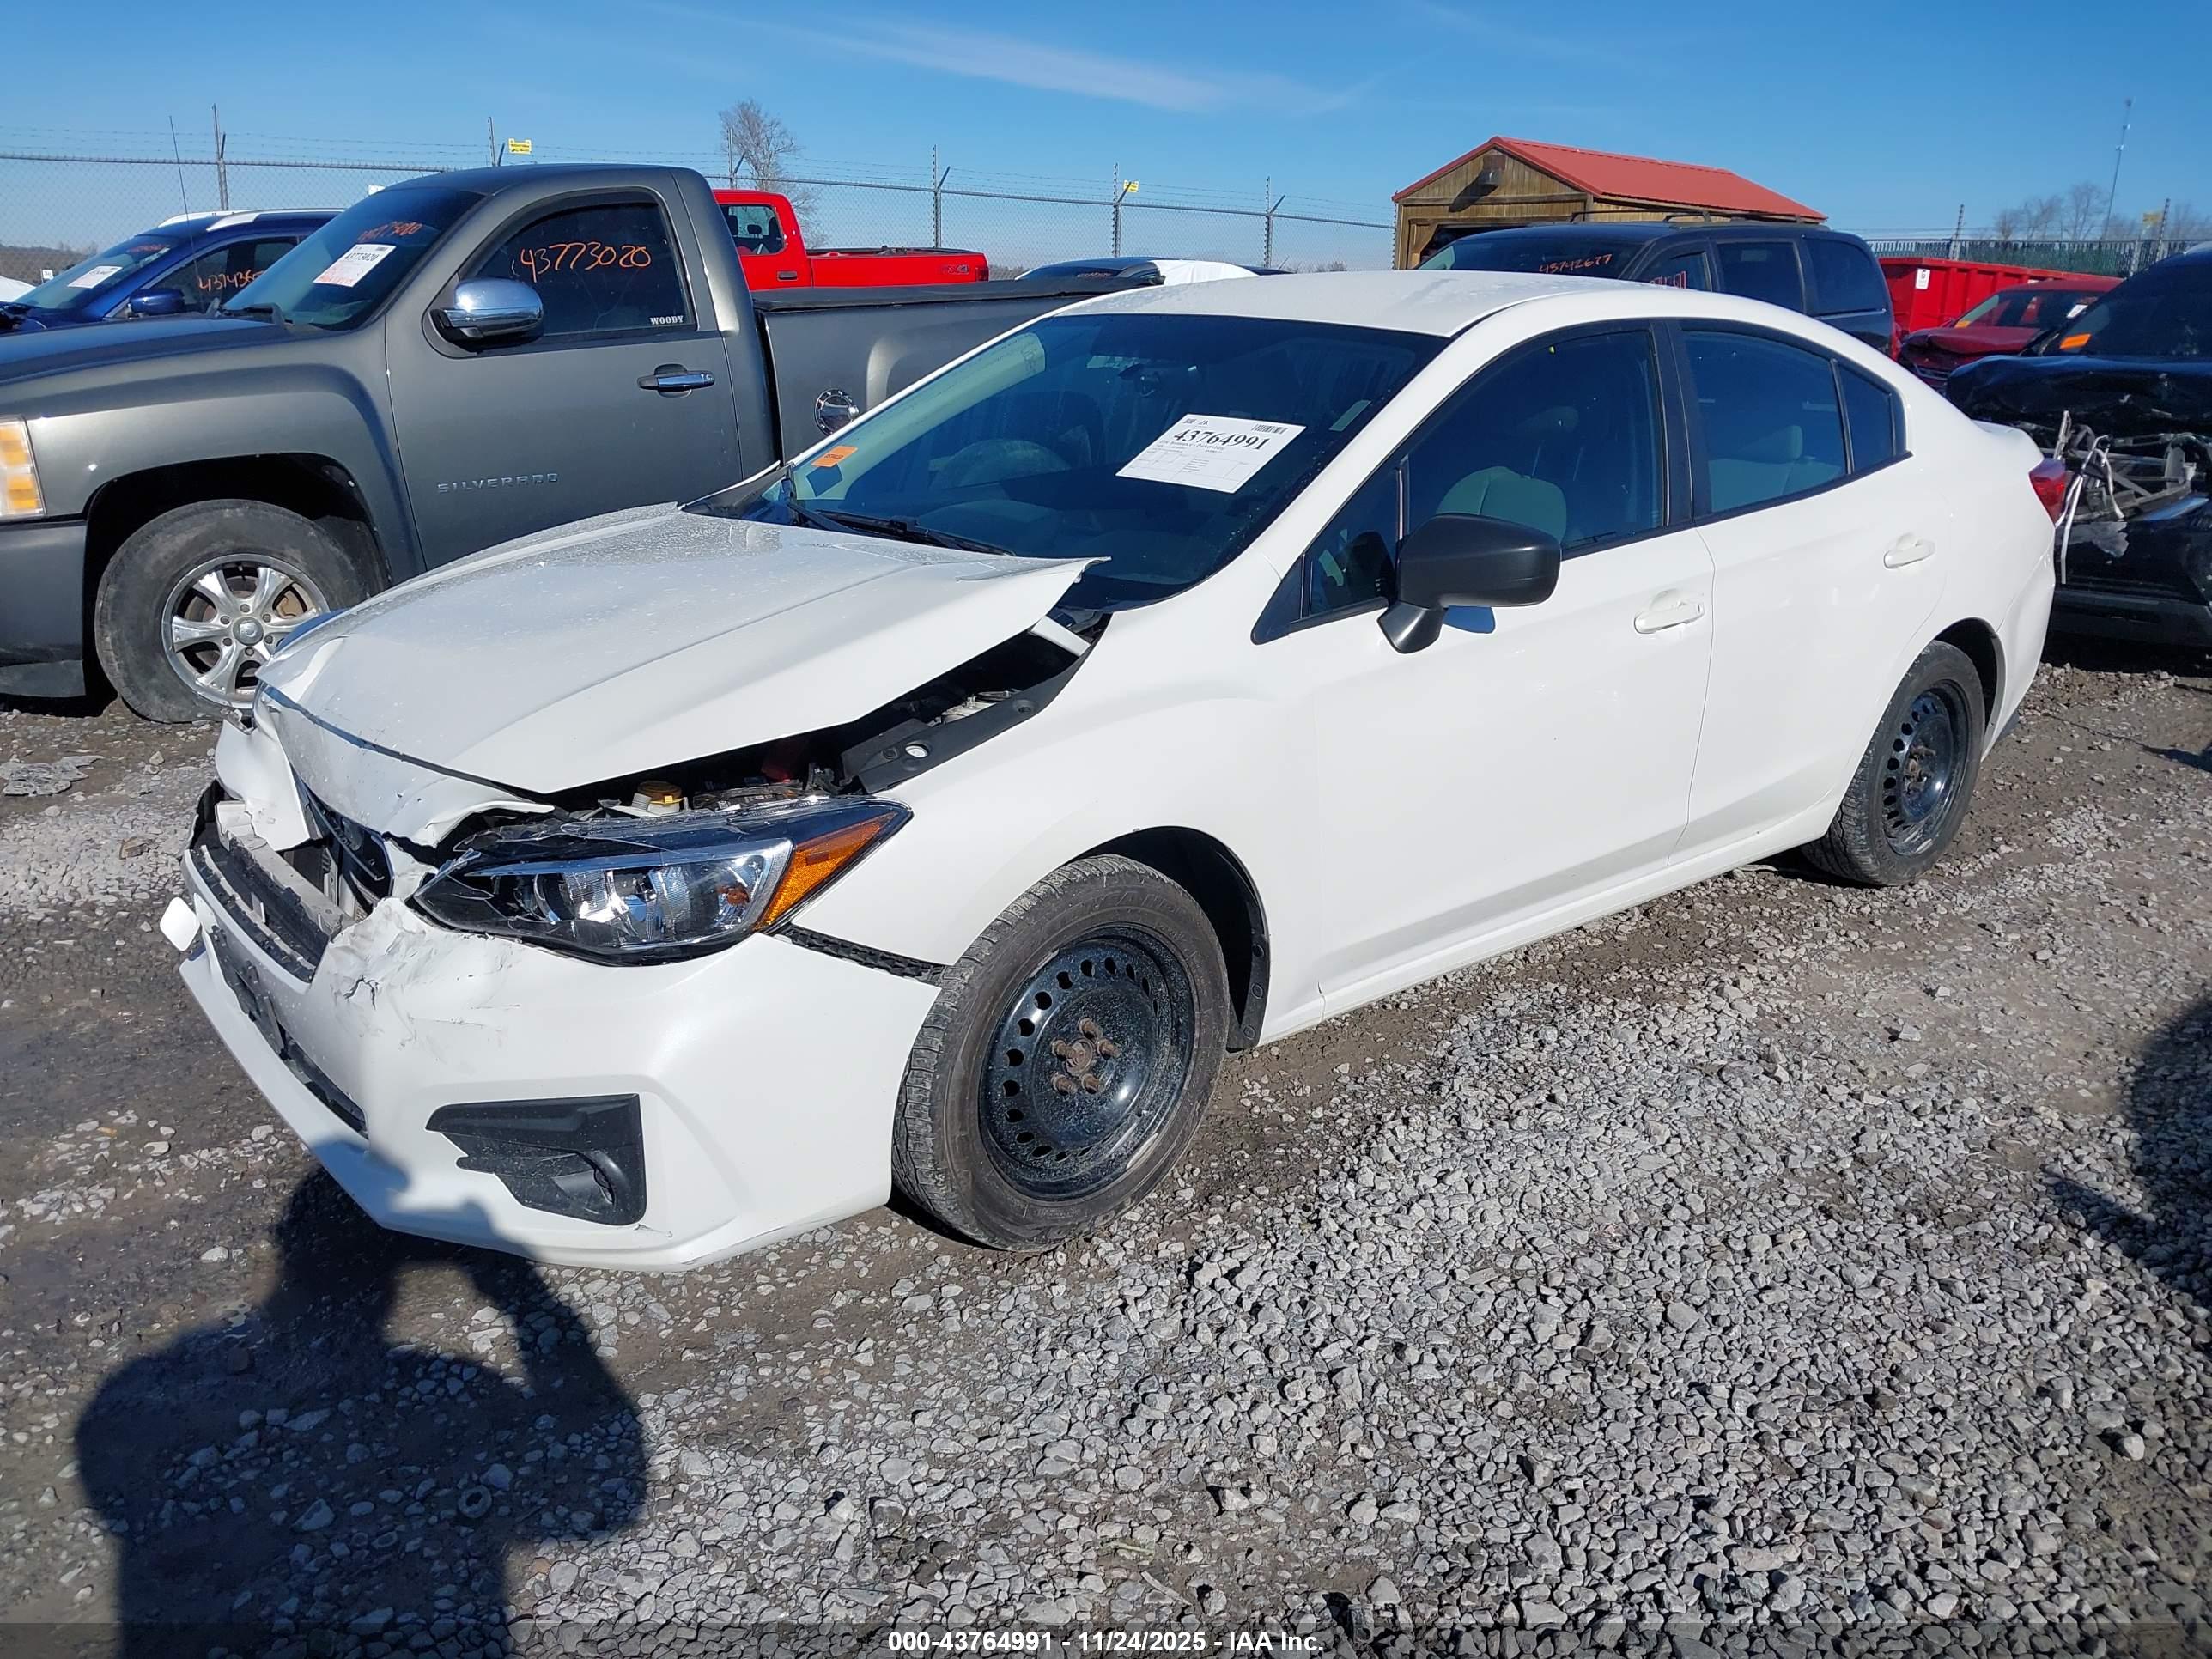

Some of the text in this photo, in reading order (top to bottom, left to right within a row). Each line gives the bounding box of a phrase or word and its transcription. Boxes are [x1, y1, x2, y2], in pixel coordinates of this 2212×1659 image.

[520, 241, 651, 283] 43773020
[1538, 253, 1613, 274] 43742677
[650, 315, 684, 325] WOODY
[1173, 428, 1270, 450] 43764991
[437, 473, 558, 493] SILVERADO
